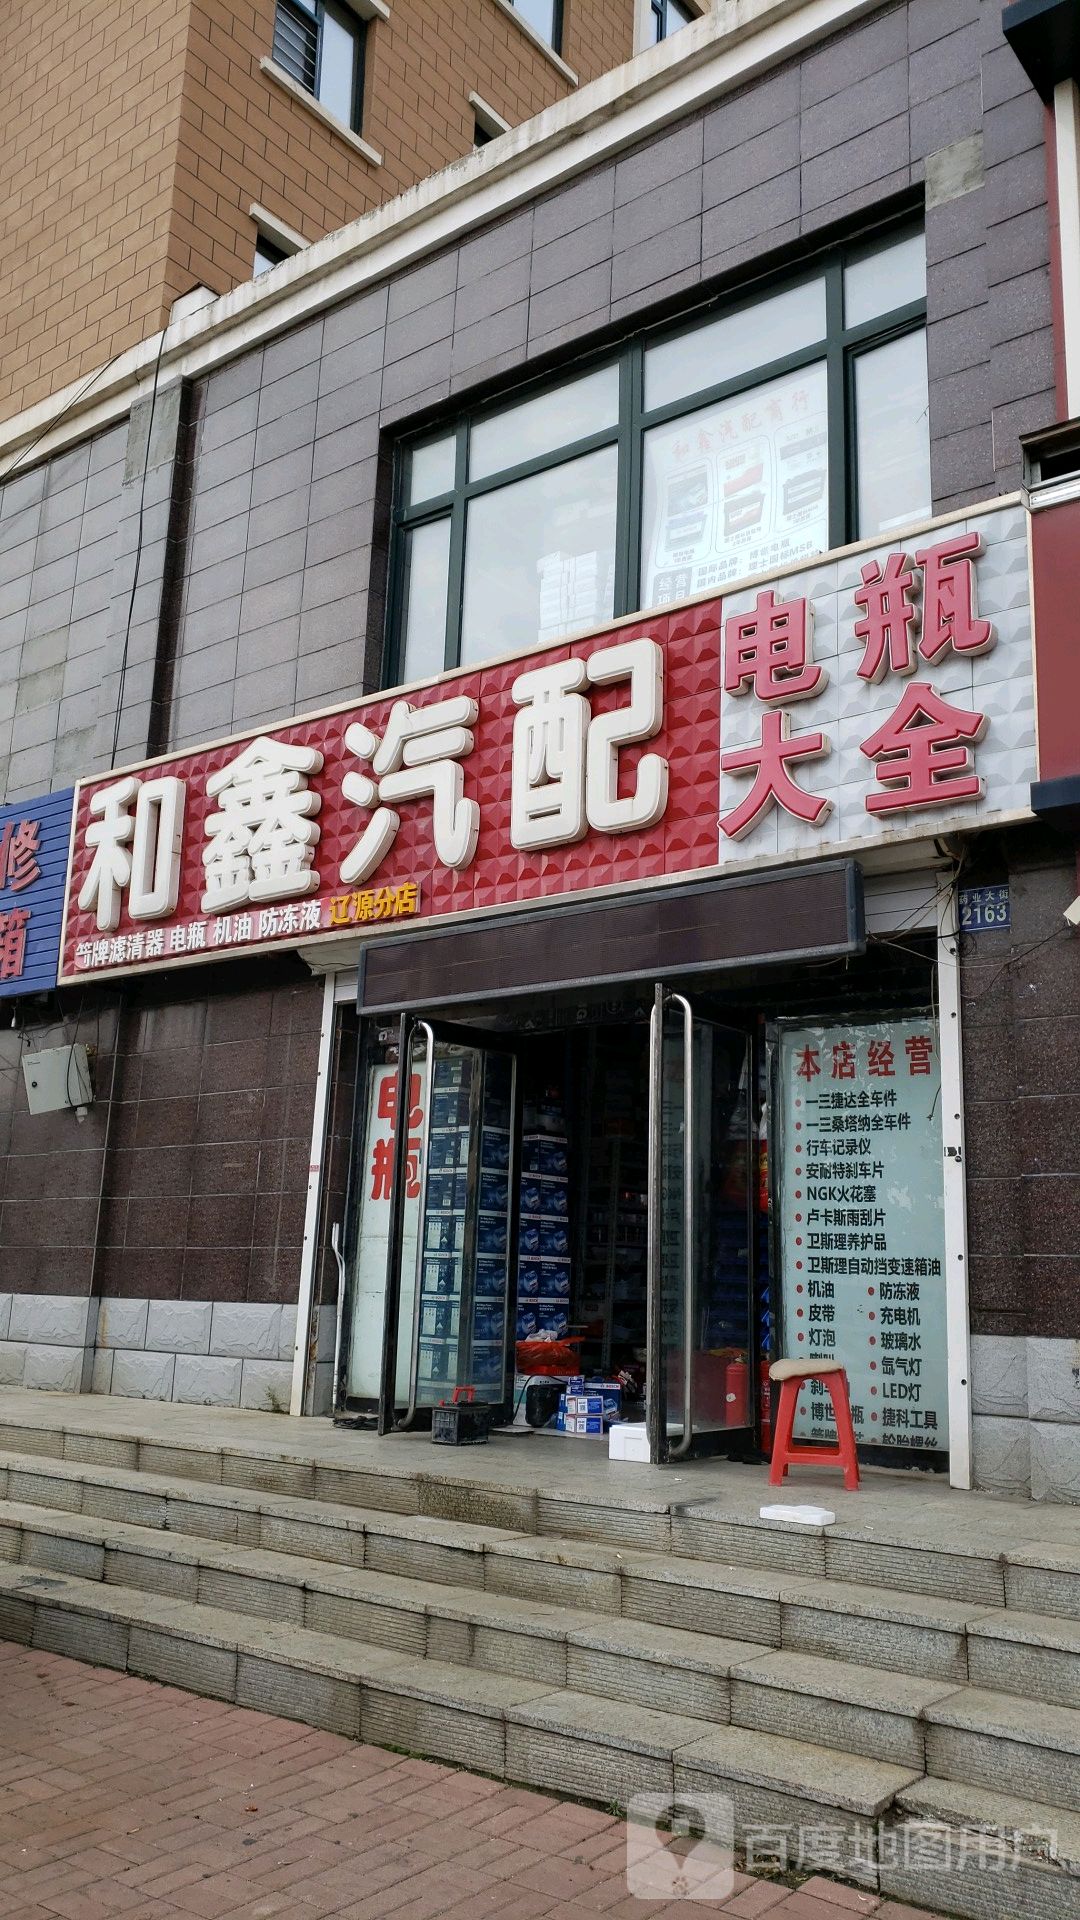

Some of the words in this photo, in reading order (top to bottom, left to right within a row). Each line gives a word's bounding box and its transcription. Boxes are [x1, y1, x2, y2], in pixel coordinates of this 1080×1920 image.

[724, 531, 998, 706] 电瓶
[717, 682, 991, 842] 大全
[78, 637, 669, 931] 和鑫汽配
[170, 921, 207, 951] 电瓶
[213, 916, 251, 943] 机油
[260, 901, 322, 935] 防冻液
[329, 881, 418, 924] 辽源分店
[962, 904, 1007, 925] 2163
[795, 1035, 933, 1082] 本店经营
[806, 1138, 871, 1156] 行车记录仪
[806, 1161, 884, 1180] 安耐特刹车片
[807, 1185, 876, 1203] NGK火花塞
[806, 1208, 886, 1227] 卢卡斯雨刮片
[807, 1232, 887, 1251] 卫斯理养护品
[807, 1257, 941, 1277] 卫斯理自动挡变速箱油
[808, 1280, 835, 1298] 机油
[879, 1282, 920, 1301] 防冻液
[808, 1304, 835, 1323] 皮带
[880, 1307, 921, 1326] 充电机
[808, 1328, 836, 1347] 灯泡
[880, 1332, 921, 1351] 玻璃水
[881, 1356, 922, 1376] 氙气灯
[882, 1382, 922, 1402] LED灯
[811, 1401, 865, 1424] 博世瓶
[882, 1408, 938, 1430] 捷科工具
